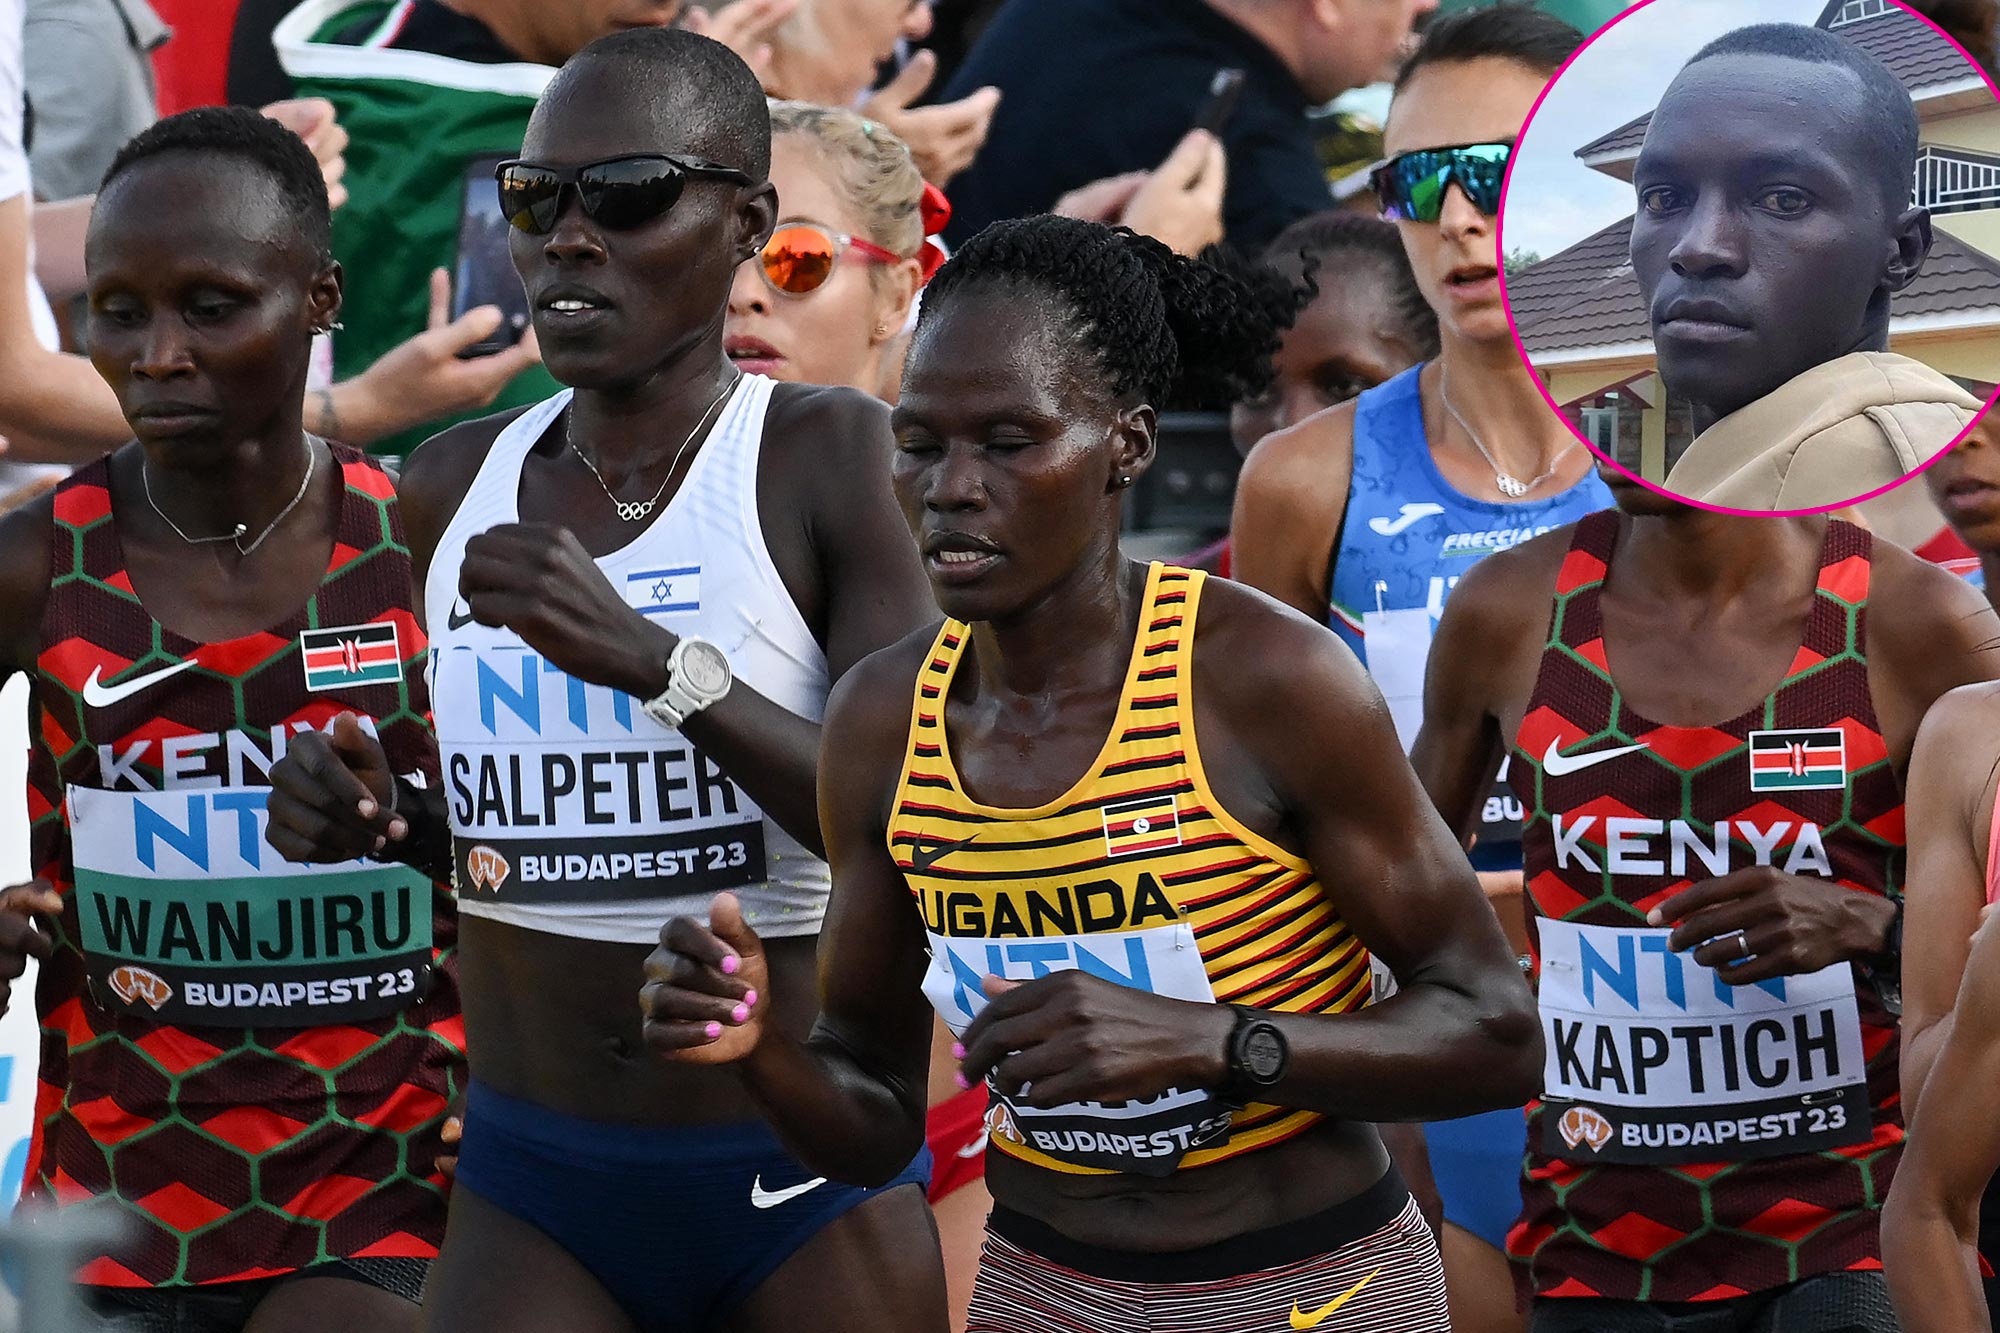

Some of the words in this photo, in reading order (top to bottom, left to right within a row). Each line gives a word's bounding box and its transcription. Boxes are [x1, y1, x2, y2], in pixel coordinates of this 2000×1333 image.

[1443, 524, 1560, 549] FRECCIA
[477, 655, 633, 737] NT
[98, 714, 379, 792] KEN
[450, 749, 738, 827] SALPETER
[133, 792, 365, 874] NT
[520, 849, 700, 882] BUDAPEST
[705, 842, 747, 871] 23
[1552, 813, 1833, 877] KENYA
[94, 887, 411, 962] WANJIRU
[919, 871, 1179, 938] UGANDA
[183, 976, 373, 1008] BUDAPEST
[378, 968, 416, 998] 23
[1552, 1009, 1841, 1096] KAPTICH
[1032, 1124, 1194, 1159] BUDAPEST
[1621, 1111, 1801, 1148] BUDAPEST
[1807, 1104, 1847, 1132] 23
